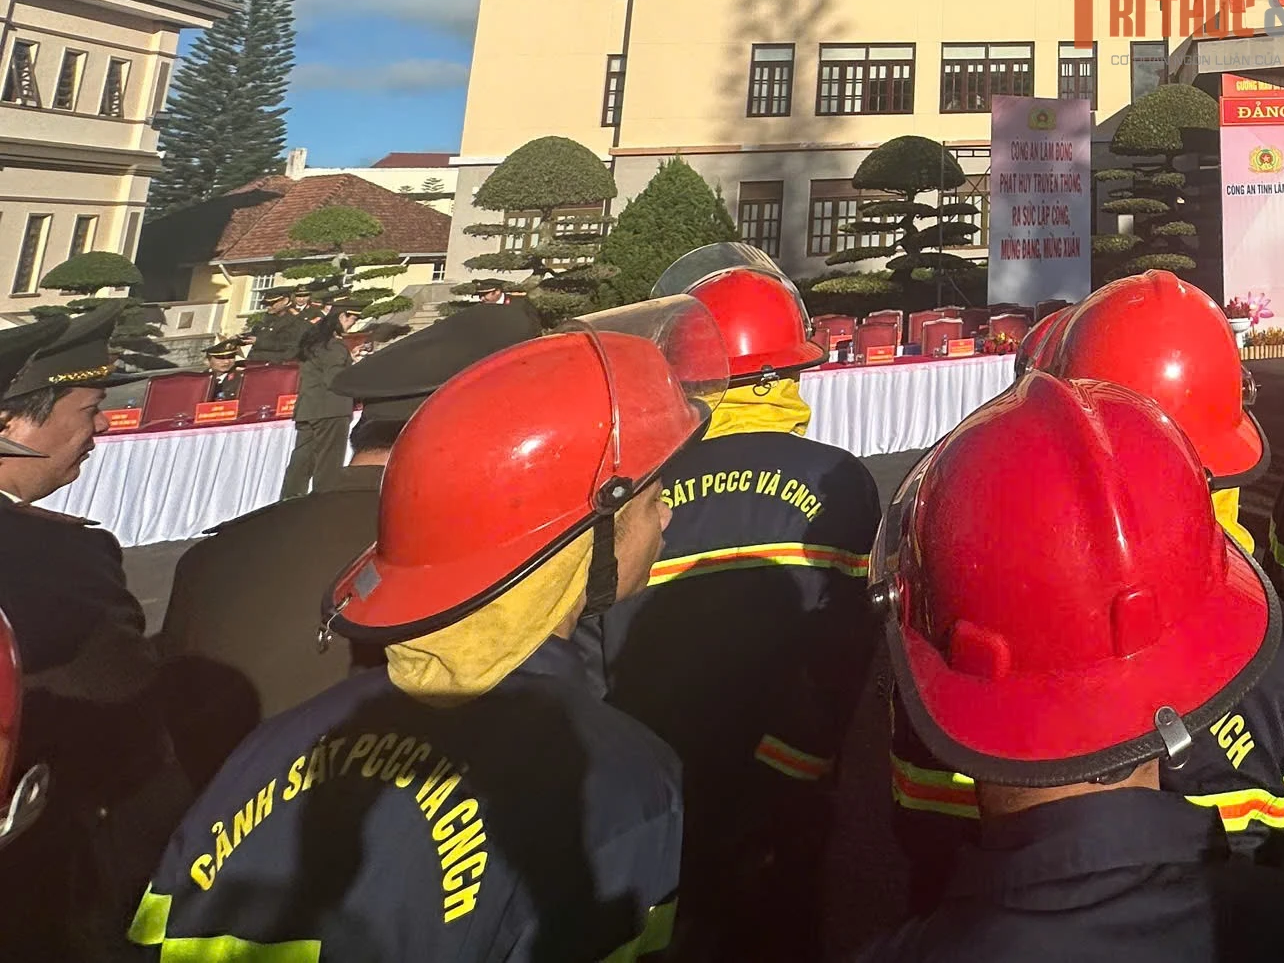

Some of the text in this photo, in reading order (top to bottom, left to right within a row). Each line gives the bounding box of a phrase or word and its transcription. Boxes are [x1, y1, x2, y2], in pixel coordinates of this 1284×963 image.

[1029, 141, 1039, 161] AN
[1018, 172, 1033, 193] HUY
[1246, 184, 1256, 195] AN
[1012, 206, 1022, 227] RA
[660, 469, 825, 522] SÁT PCCC VÀ CNCH
[190, 733, 491, 924] CẢNH SÁT PCCC VÀ CNCH
